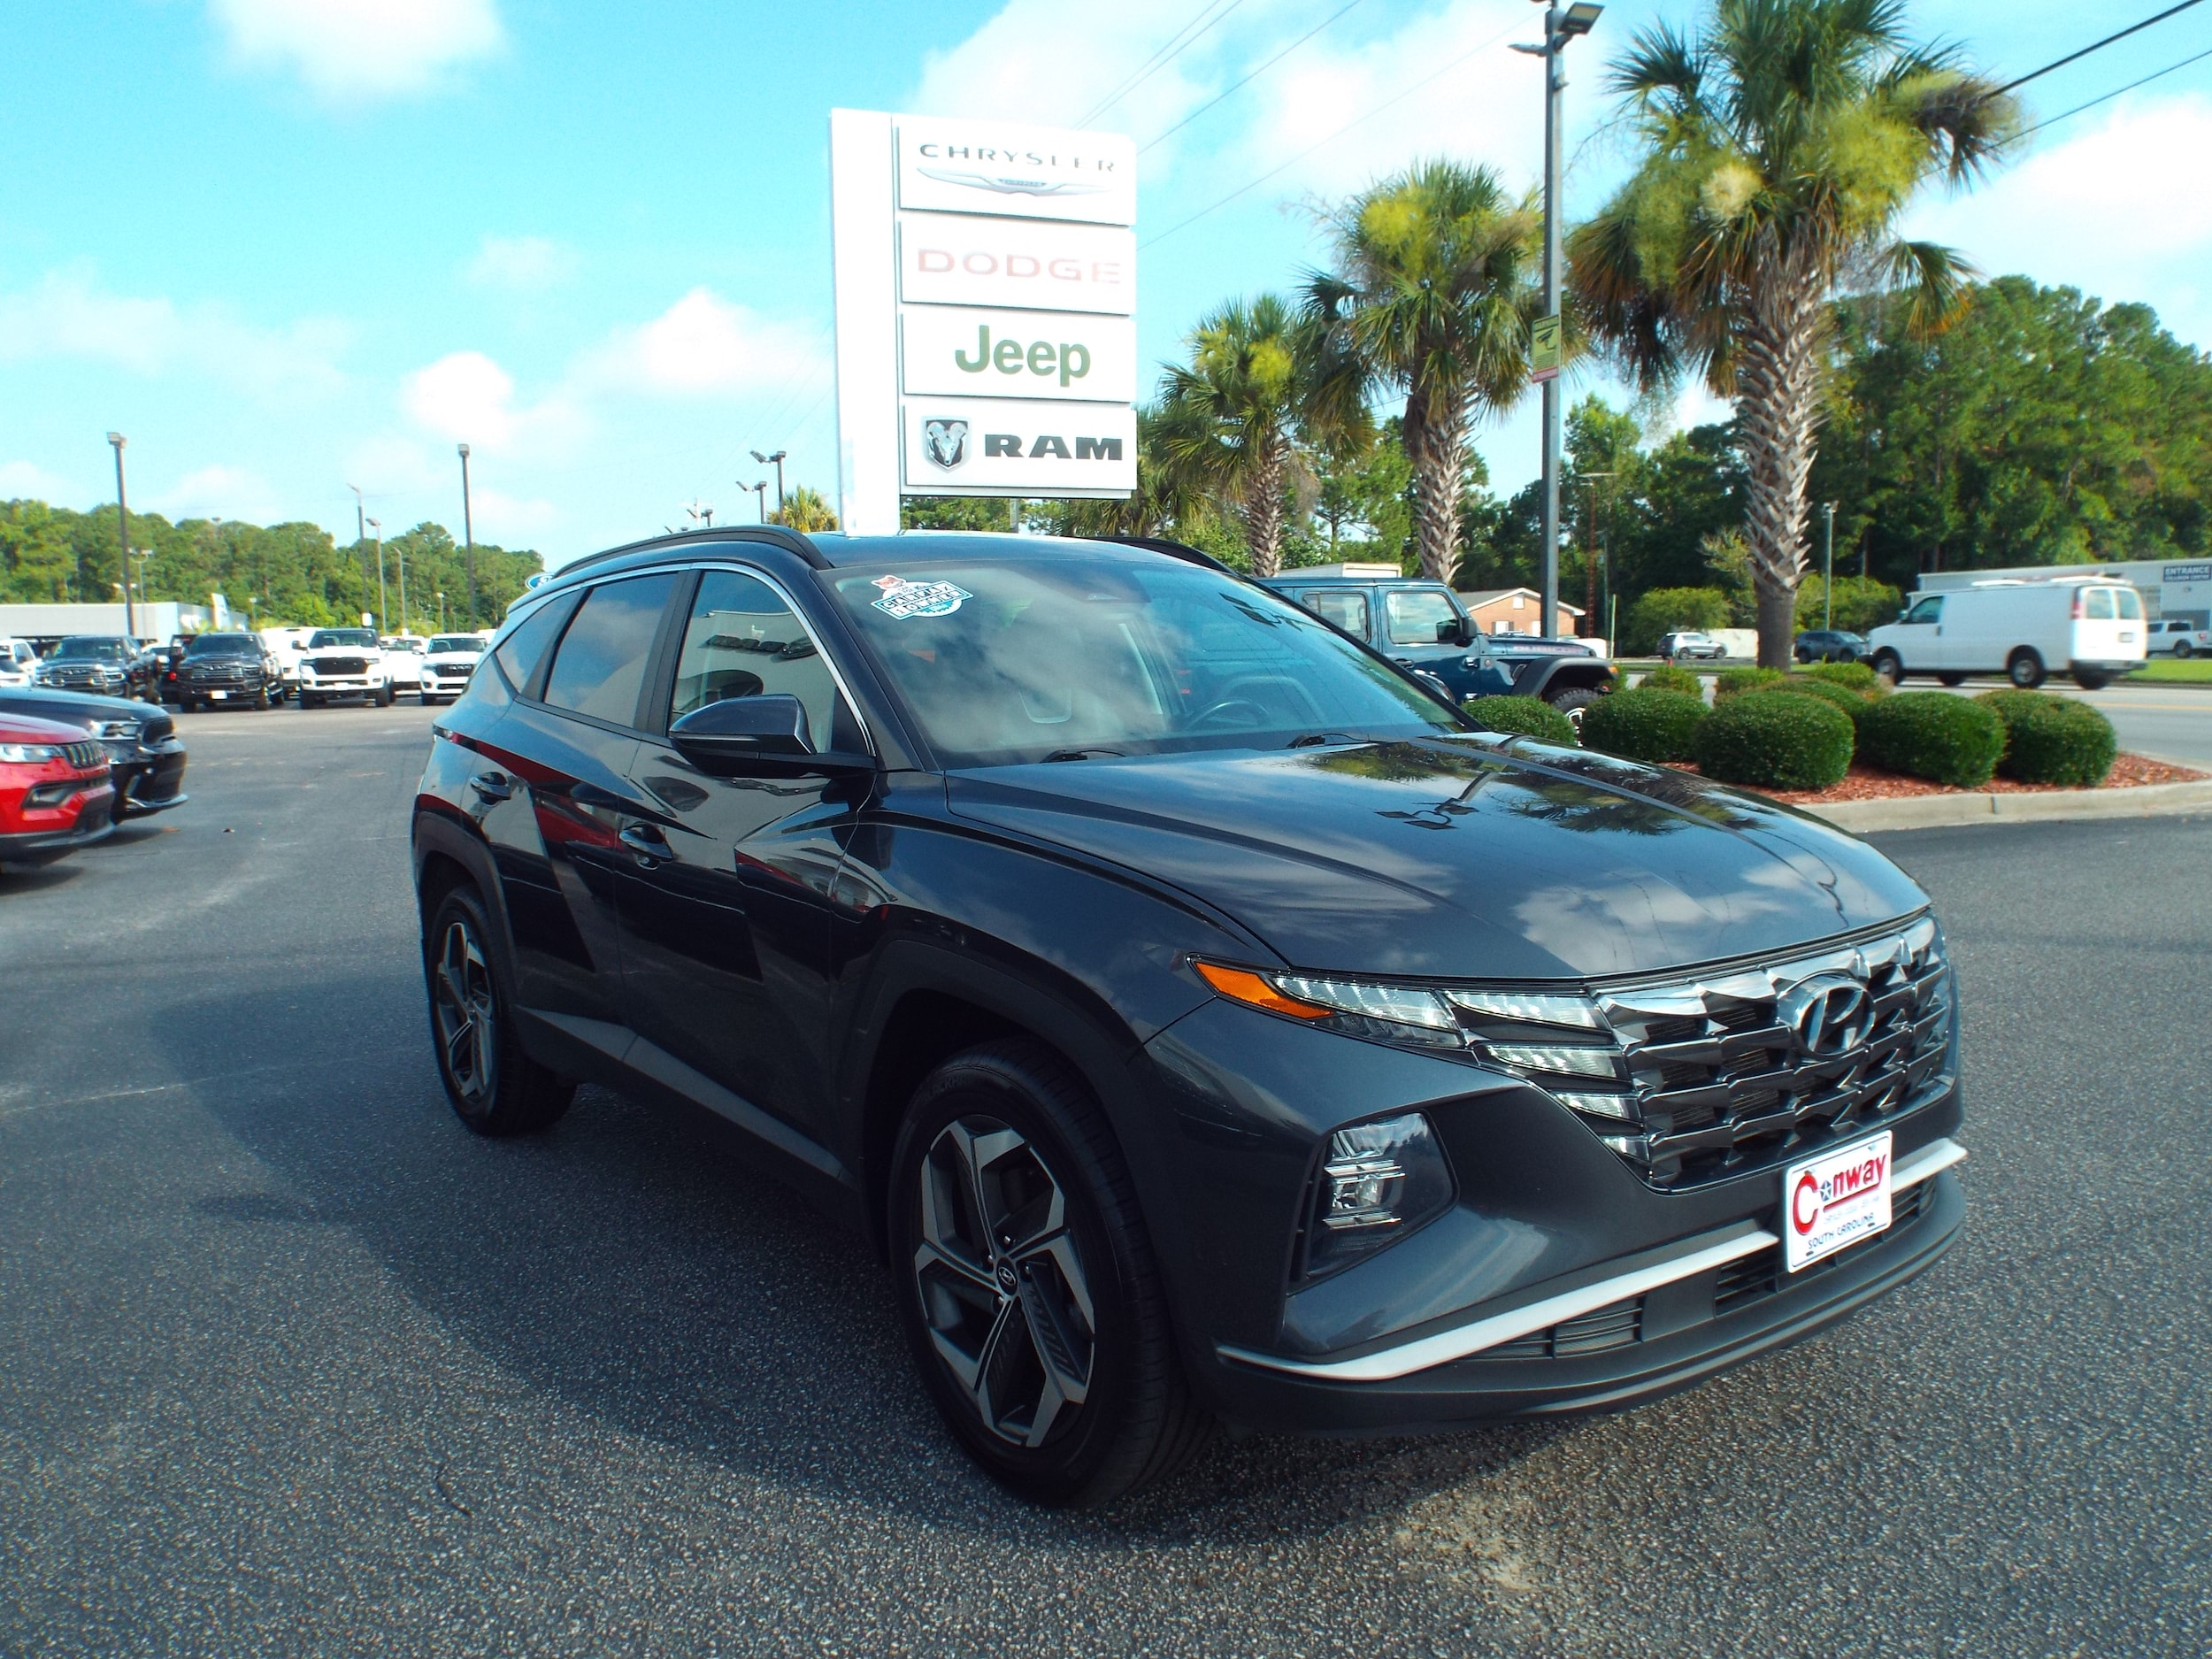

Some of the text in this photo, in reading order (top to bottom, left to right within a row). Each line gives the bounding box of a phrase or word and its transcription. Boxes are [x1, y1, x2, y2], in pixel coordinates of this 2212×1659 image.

[918, 142, 1115, 173] CHRYSLER
[918, 249, 1121, 284] DODGE
[955, 325, 1091, 388] Jeep
[984, 434, 1123, 461] RAM
[1808, 1230, 1834, 1249] SOUTH
